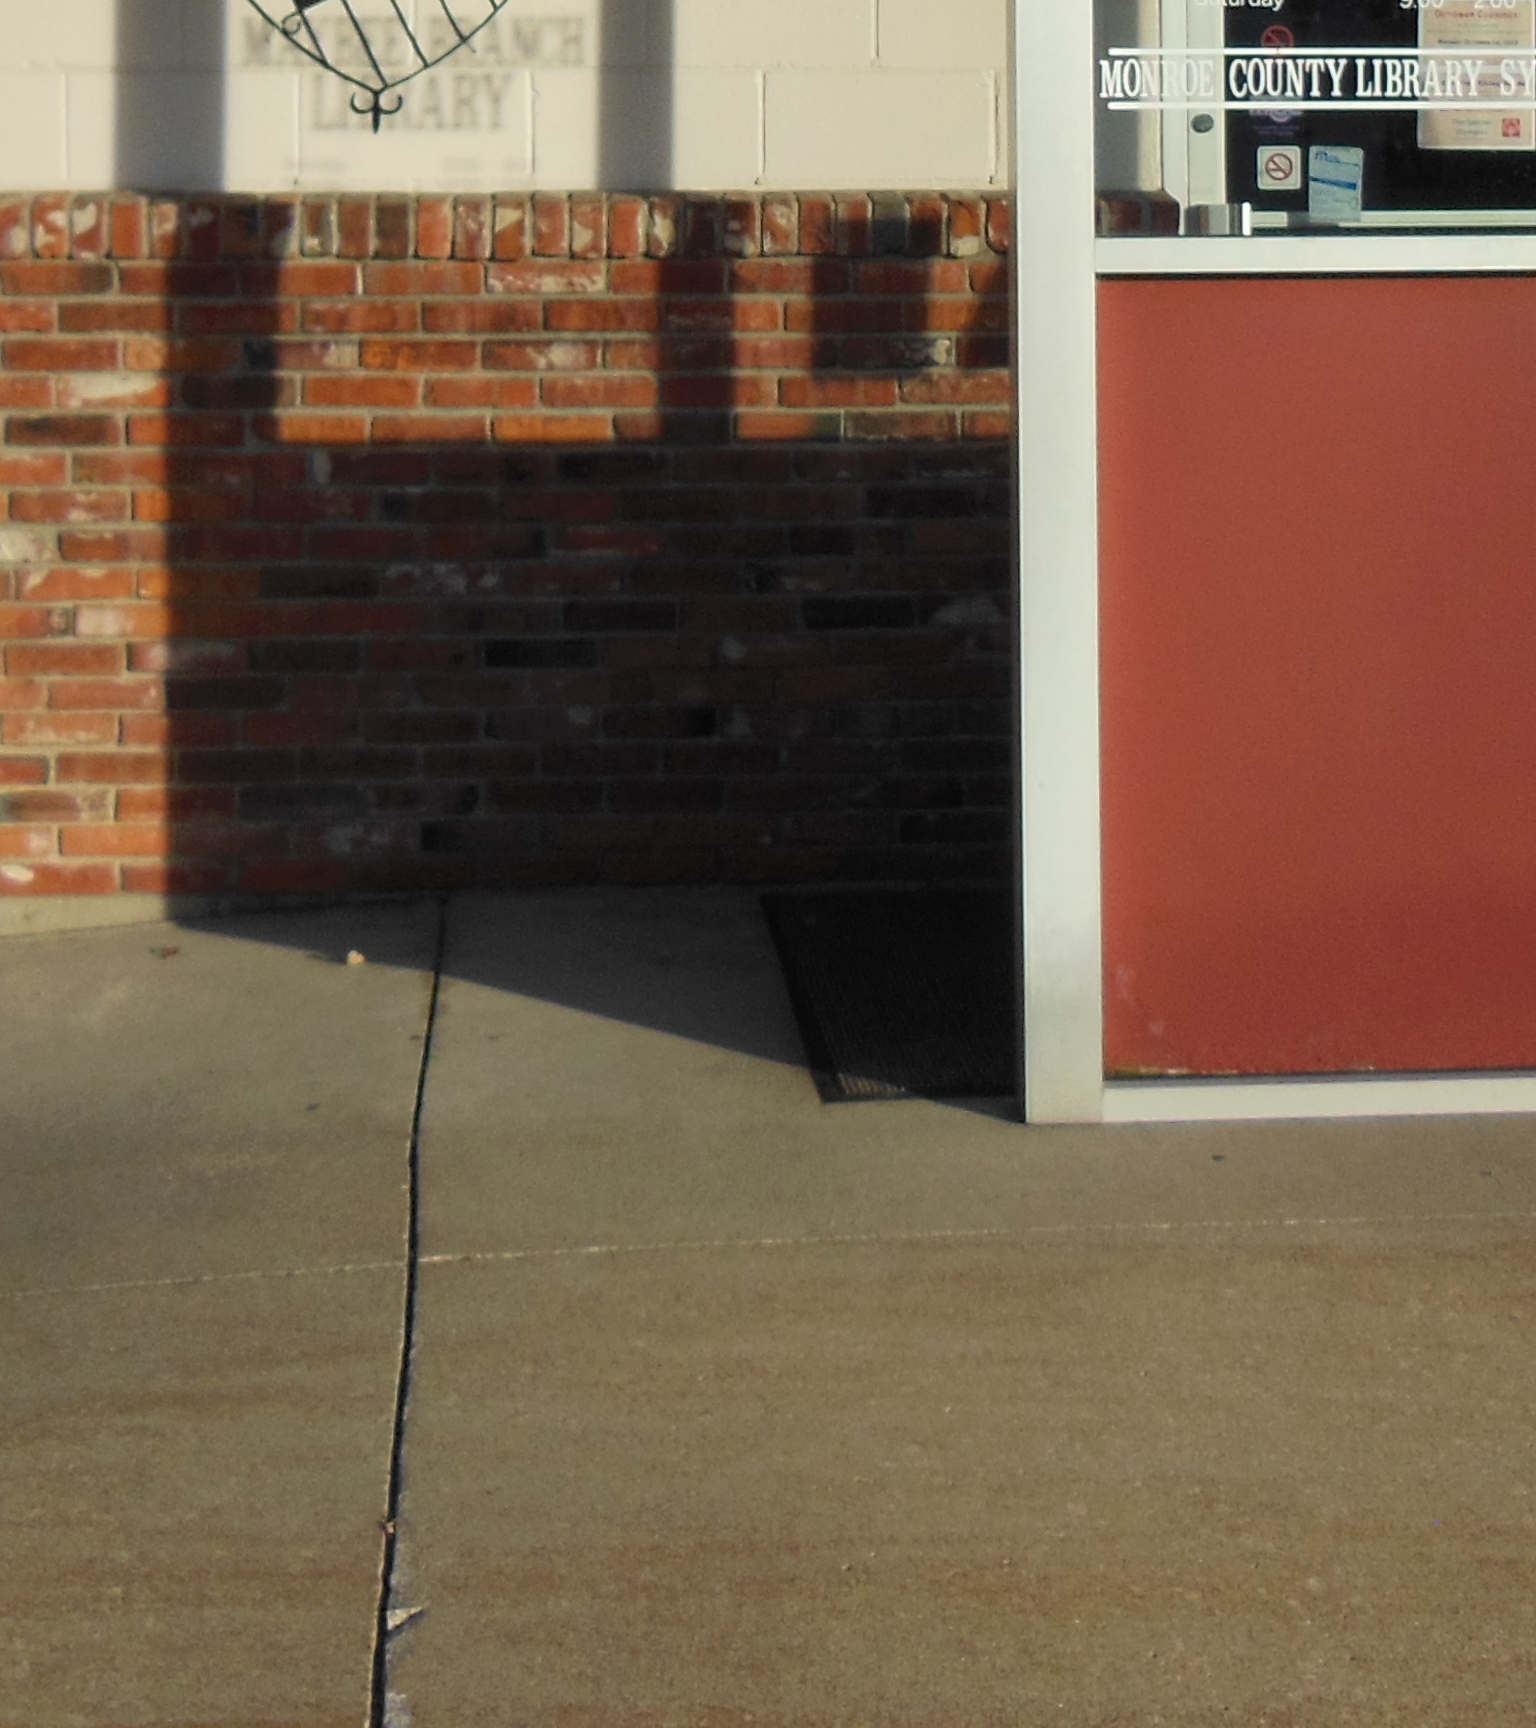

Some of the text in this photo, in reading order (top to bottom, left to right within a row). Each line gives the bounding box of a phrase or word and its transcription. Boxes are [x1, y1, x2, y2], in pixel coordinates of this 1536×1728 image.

[1099, 58, 1214, 98] MONROE
[1229, 58, 1347, 98] COUNTY
[1355, 58, 1483, 98] LIBRARY
